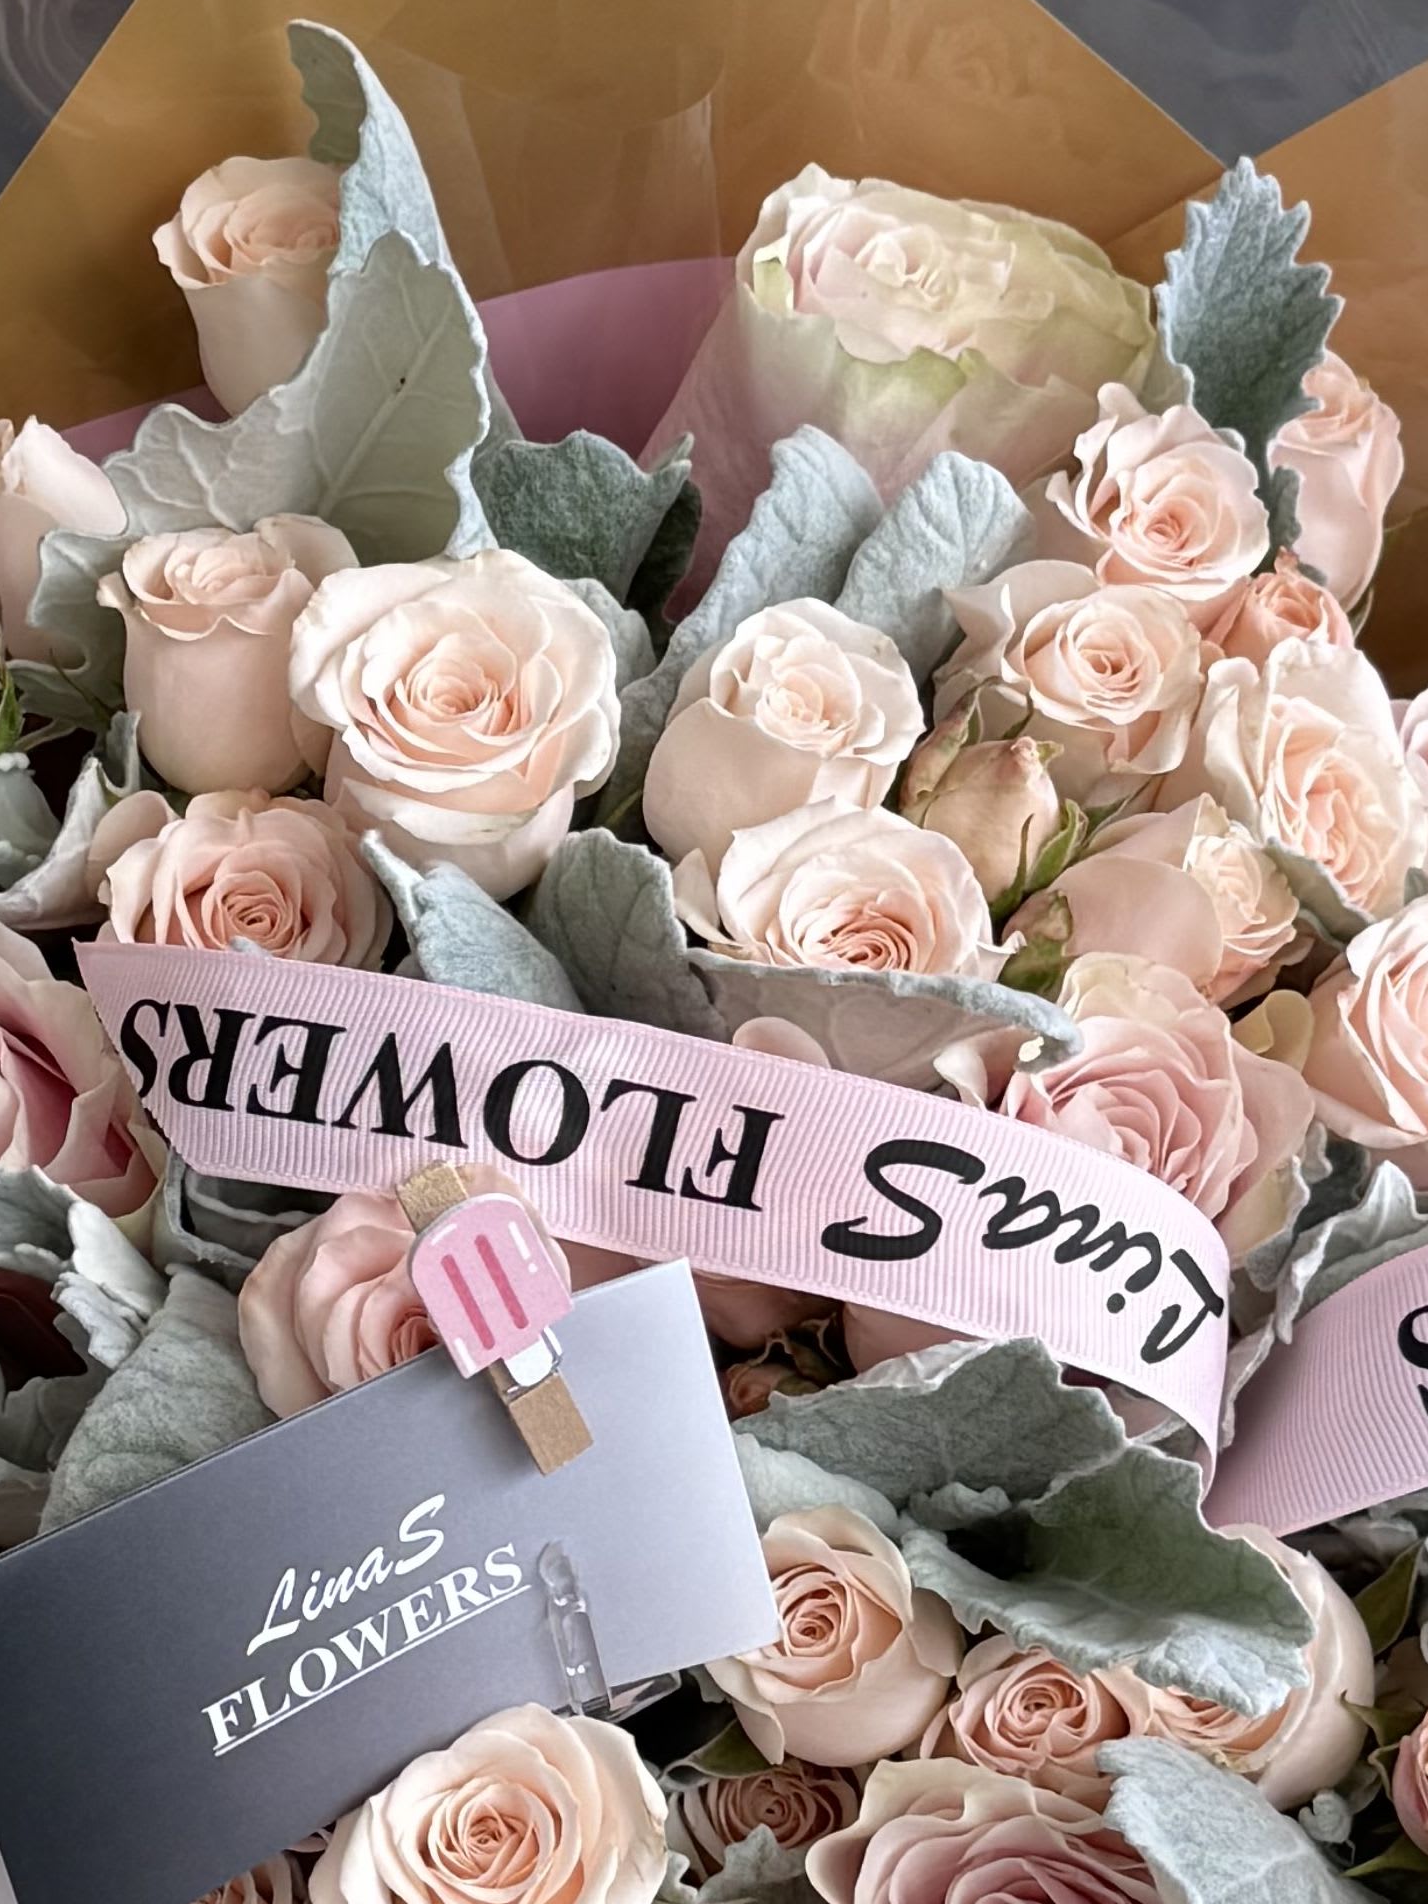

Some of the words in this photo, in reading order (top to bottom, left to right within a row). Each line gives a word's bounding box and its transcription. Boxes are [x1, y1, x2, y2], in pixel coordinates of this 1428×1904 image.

[118, 997, 786, 1211] FLOWERS
[820, 1138, 1225, 1364] LinaS
[201, 1542, 524, 1752] FLOWERS
[247, 1493, 445, 1656] LinaS
